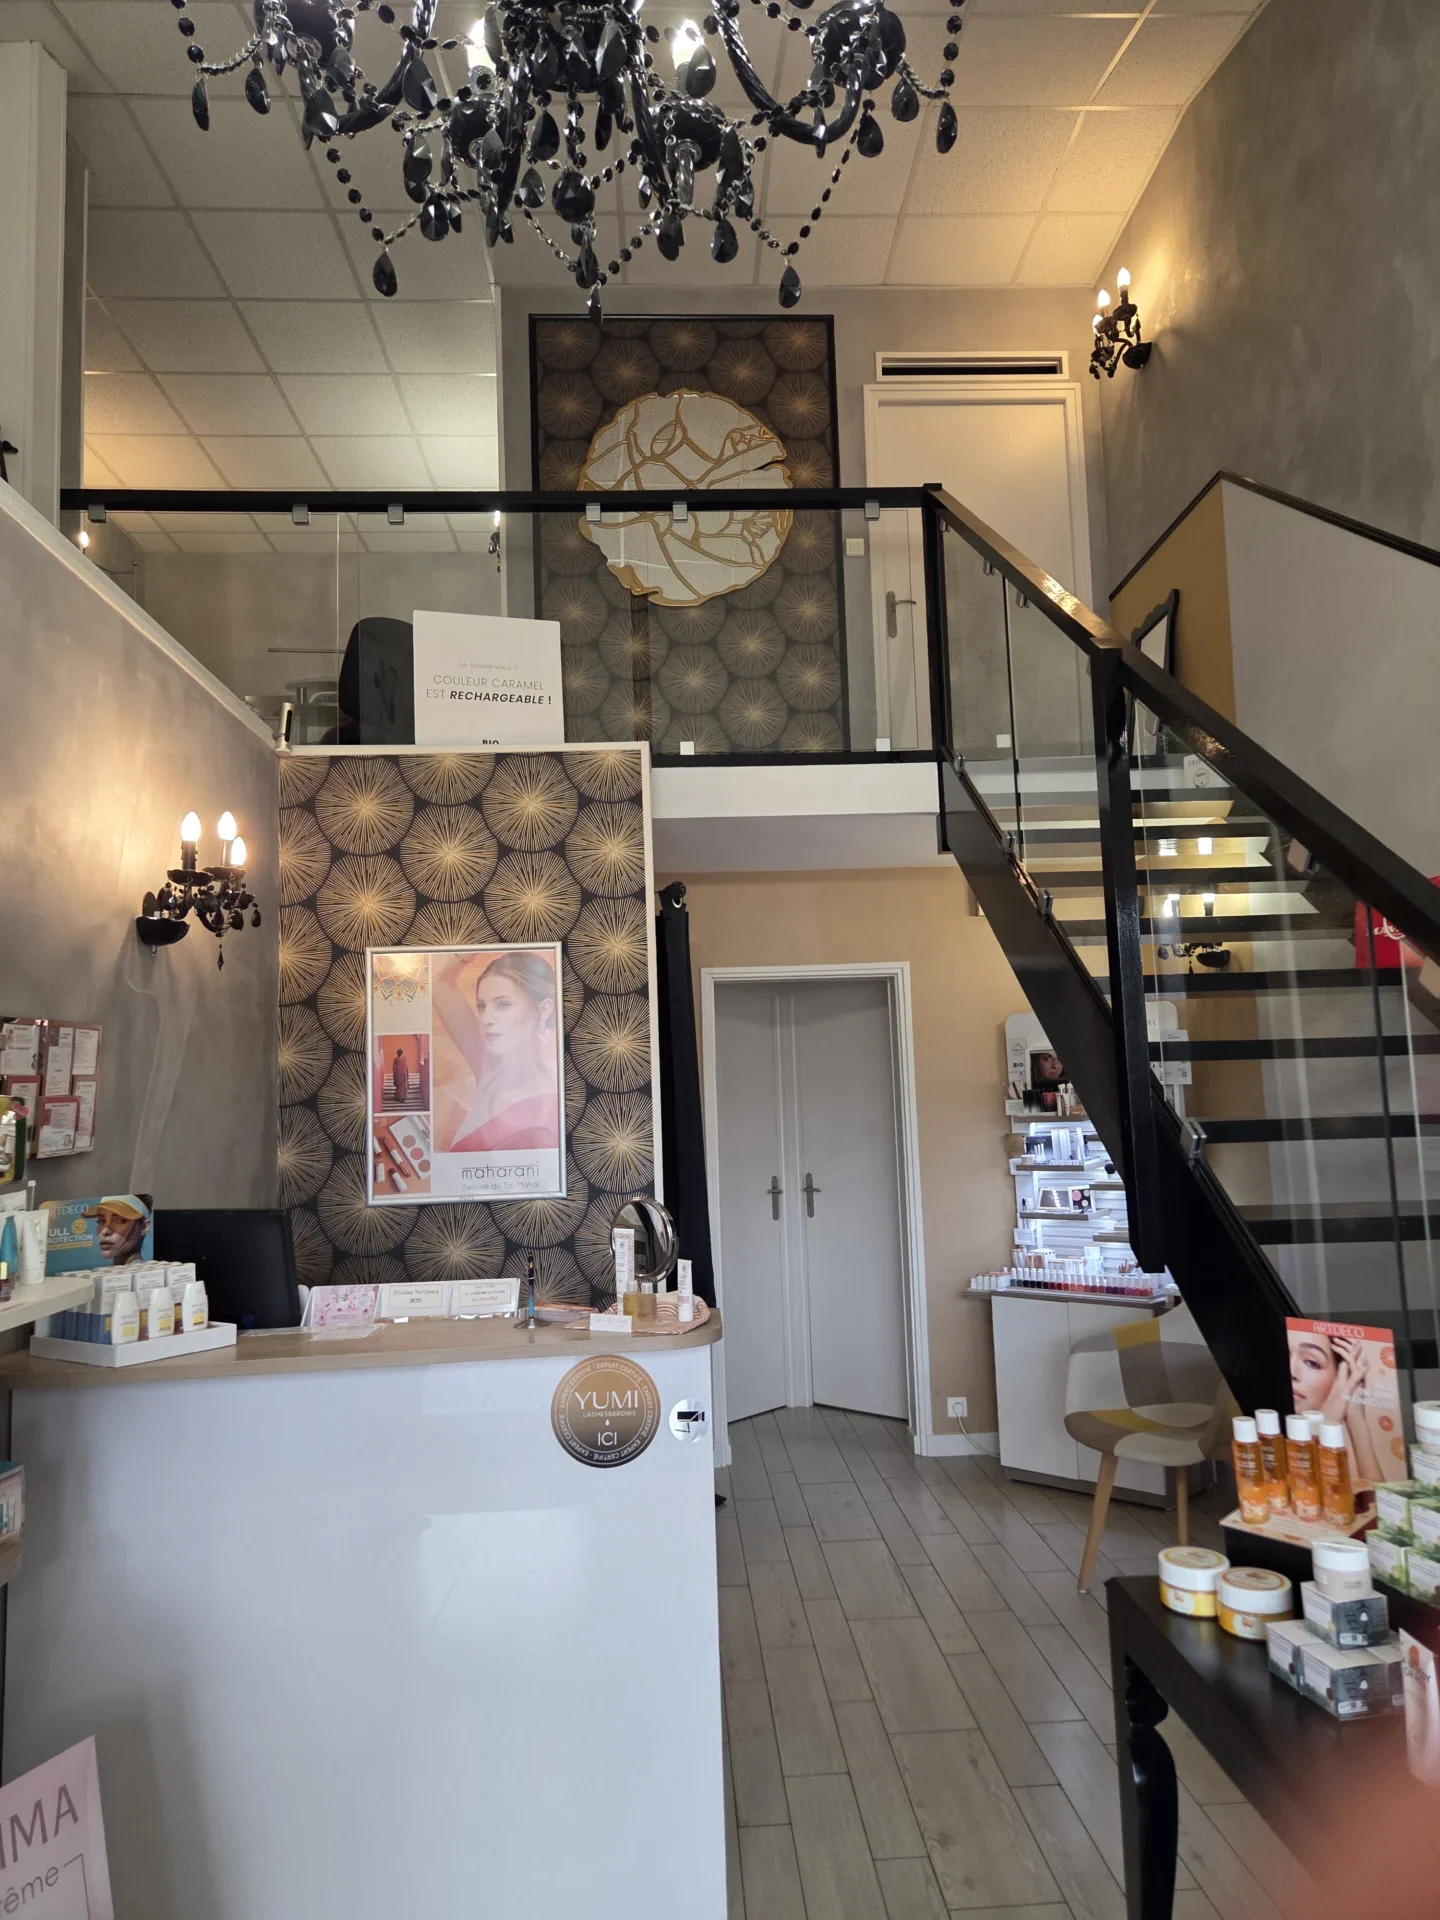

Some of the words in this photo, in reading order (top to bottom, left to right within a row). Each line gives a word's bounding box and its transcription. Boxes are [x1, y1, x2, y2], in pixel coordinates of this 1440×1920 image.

[433, 674, 488, 687] COULEUR
[492, 678, 545, 691] CARAMEL
[426, 688, 446, 699] EST
[449, 690, 545, 705] RECHARGEABLE
[461, 1160, 540, 1180] maharani
[49, 1203, 90, 1217] RTDECO
[47, 1233, 93, 1244] ROTECTION
[48, 1227, 70, 1237] ULL
[1312, 1321, 1365, 1338] ARTDECO
[596, 1362, 619, 1370] EXPERT
[574, 1390, 638, 1410] YUMI
[597, 1431, 617, 1446] ICI
[0, 1866, 60, 1915] ême
